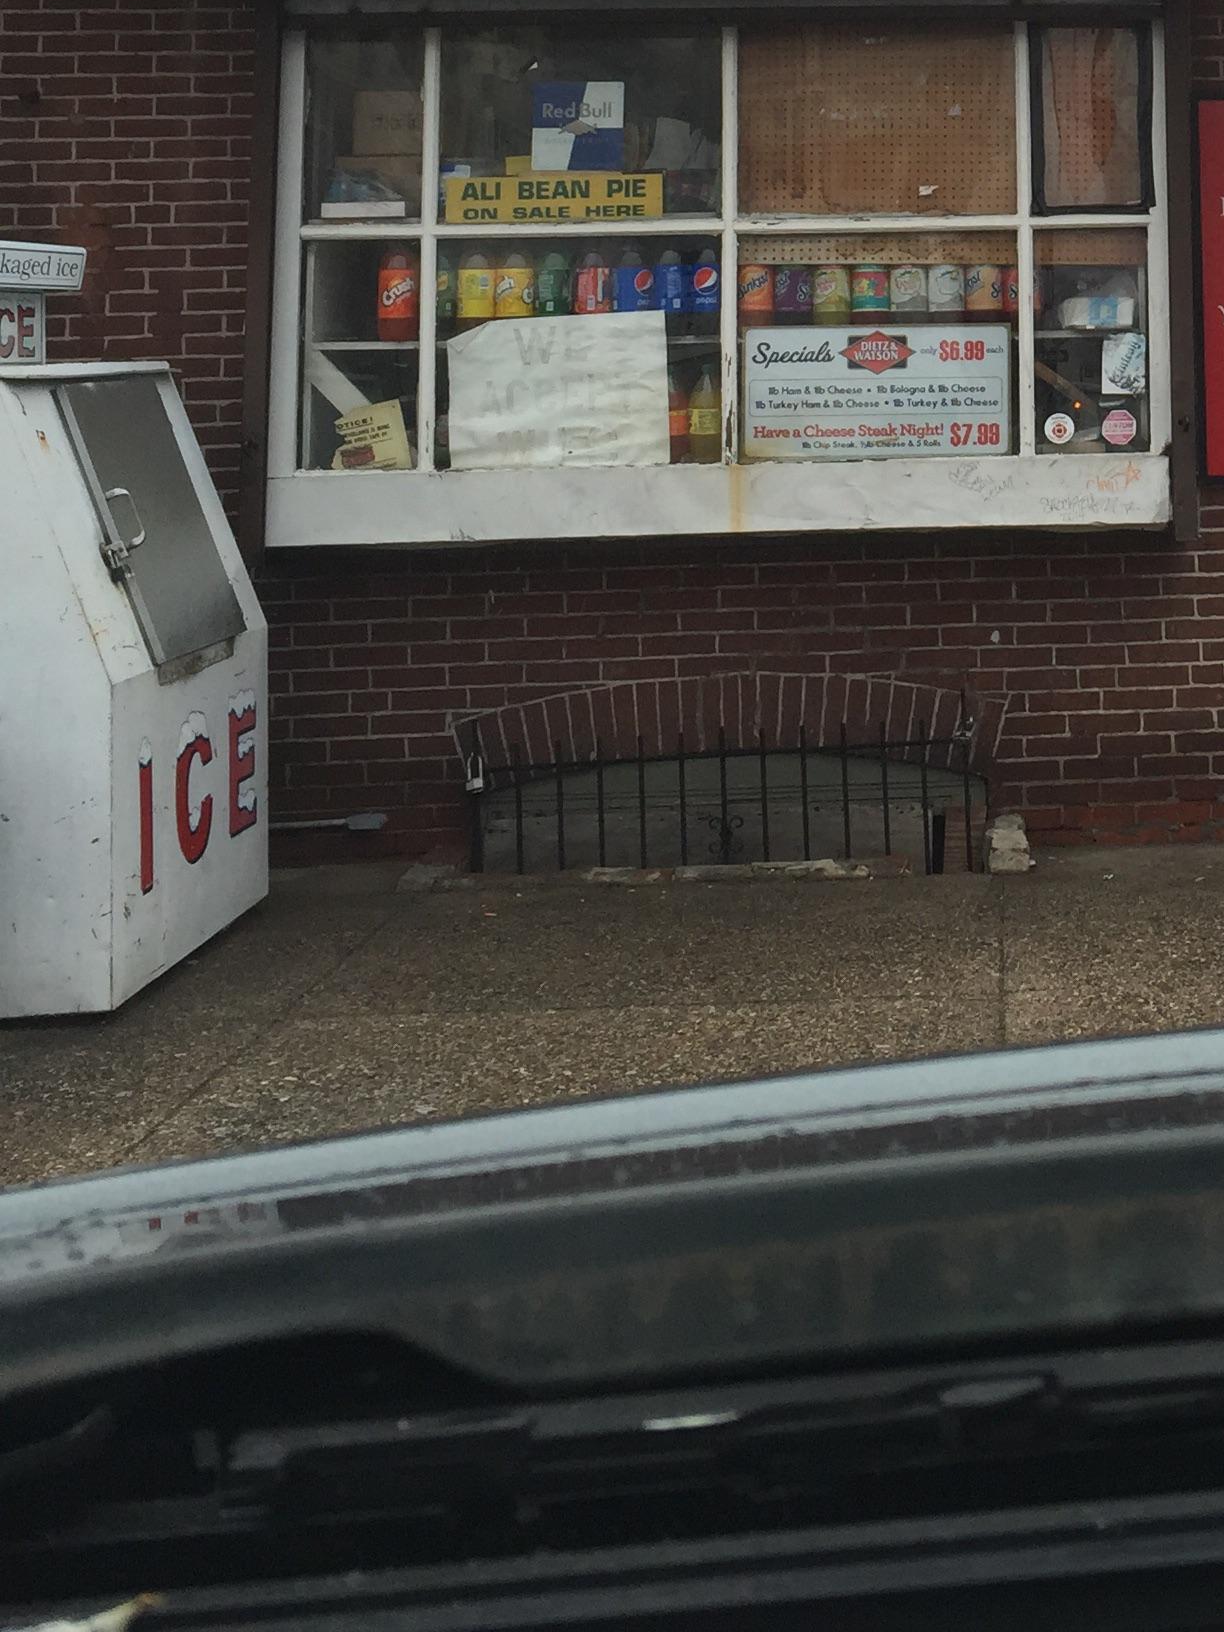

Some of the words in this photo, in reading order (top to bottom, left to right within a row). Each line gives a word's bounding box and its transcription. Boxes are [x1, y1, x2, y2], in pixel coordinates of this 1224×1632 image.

[541, 101, 576, 119] Red
[579, 101, 612, 118] Bull
[461, 182, 502, 201] ALI
[518, 180, 590, 200] BEAN
[606, 178, 646, 199] PIE
[463, 207, 498, 220] ON
[512, 205, 571, 219] SALE
[585, 204, 645, 217] HERE
[56, 258, 79, 277] ice
[382, 276, 415, 307] Crush
[752, 341, 835, 368] Specials
[860, 340, 890, 351] DIETZ
[938, 339, 985, 362] $6.99
[986, 345, 1004, 354] each
[853, 350, 898, 361] WATSON
[781, 386, 801, 395] Ham
[804, 386, 811, 395] &
[827, 385, 863, 394] Cheese
[889, 384, 926, 395] Bologna
[928, 384, 935, 393] &
[951, 383, 986, 393] Cheese
[768, 400, 799, 411] Turkey
[801, 400, 821, 409] Ham
[823, 400, 830, 408] &
[845, 399, 880, 408] Cheese
[907, 398, 938, 409] Turkey
[941, 398, 948, 407] &
[964, 397, 999, 406] Cheese
[753, 425, 790, 439] Have
[792, 428, 801, 438] a
[804, 424, 855, 437] Cheese
[858, 423, 898, 436] Steak
[900, 422, 944, 438] Night!
[950, 422, 1000, 447] $7.99
[876, 440, 905, 449] Cheese
[924, 439, 941, 447] Rolls
[139, 688, 258, 896] ICE
